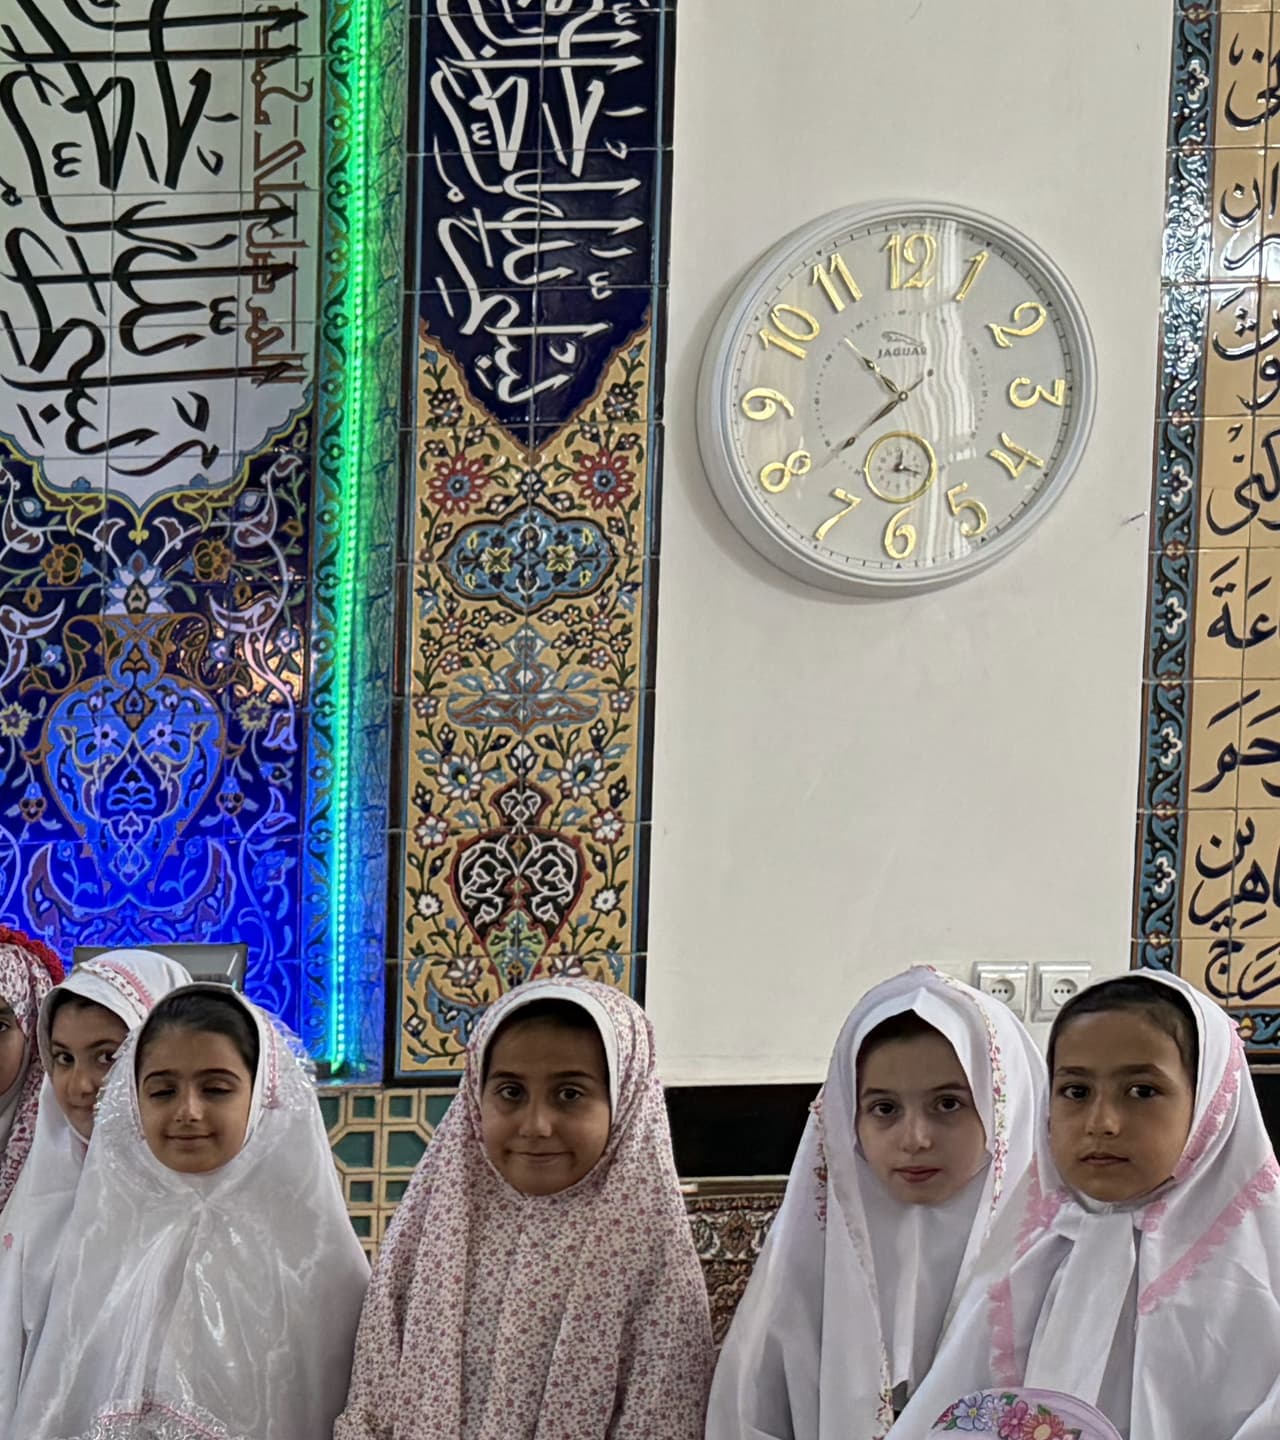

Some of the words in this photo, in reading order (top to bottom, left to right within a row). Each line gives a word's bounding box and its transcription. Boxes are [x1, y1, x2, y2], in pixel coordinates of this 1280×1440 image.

[810, 251, 864, 314] 11
[879, 233, 937, 290] 12
[954, 250, 990, 303] 1
[758, 301, 821, 360] 10
[985, 301, 1047, 348] 2
[877, 346, 927, 359] JAGUAR
[740, 386, 796, 418] 9
[1008, 376, 1067, 410] 3
[759, 449, 812, 494] 8
[989, 431, 1045, 480] 4
[814, 487, 863, 542] 7
[883, 505, 918, 561] 6
[946, 481, 990, 538] 5
